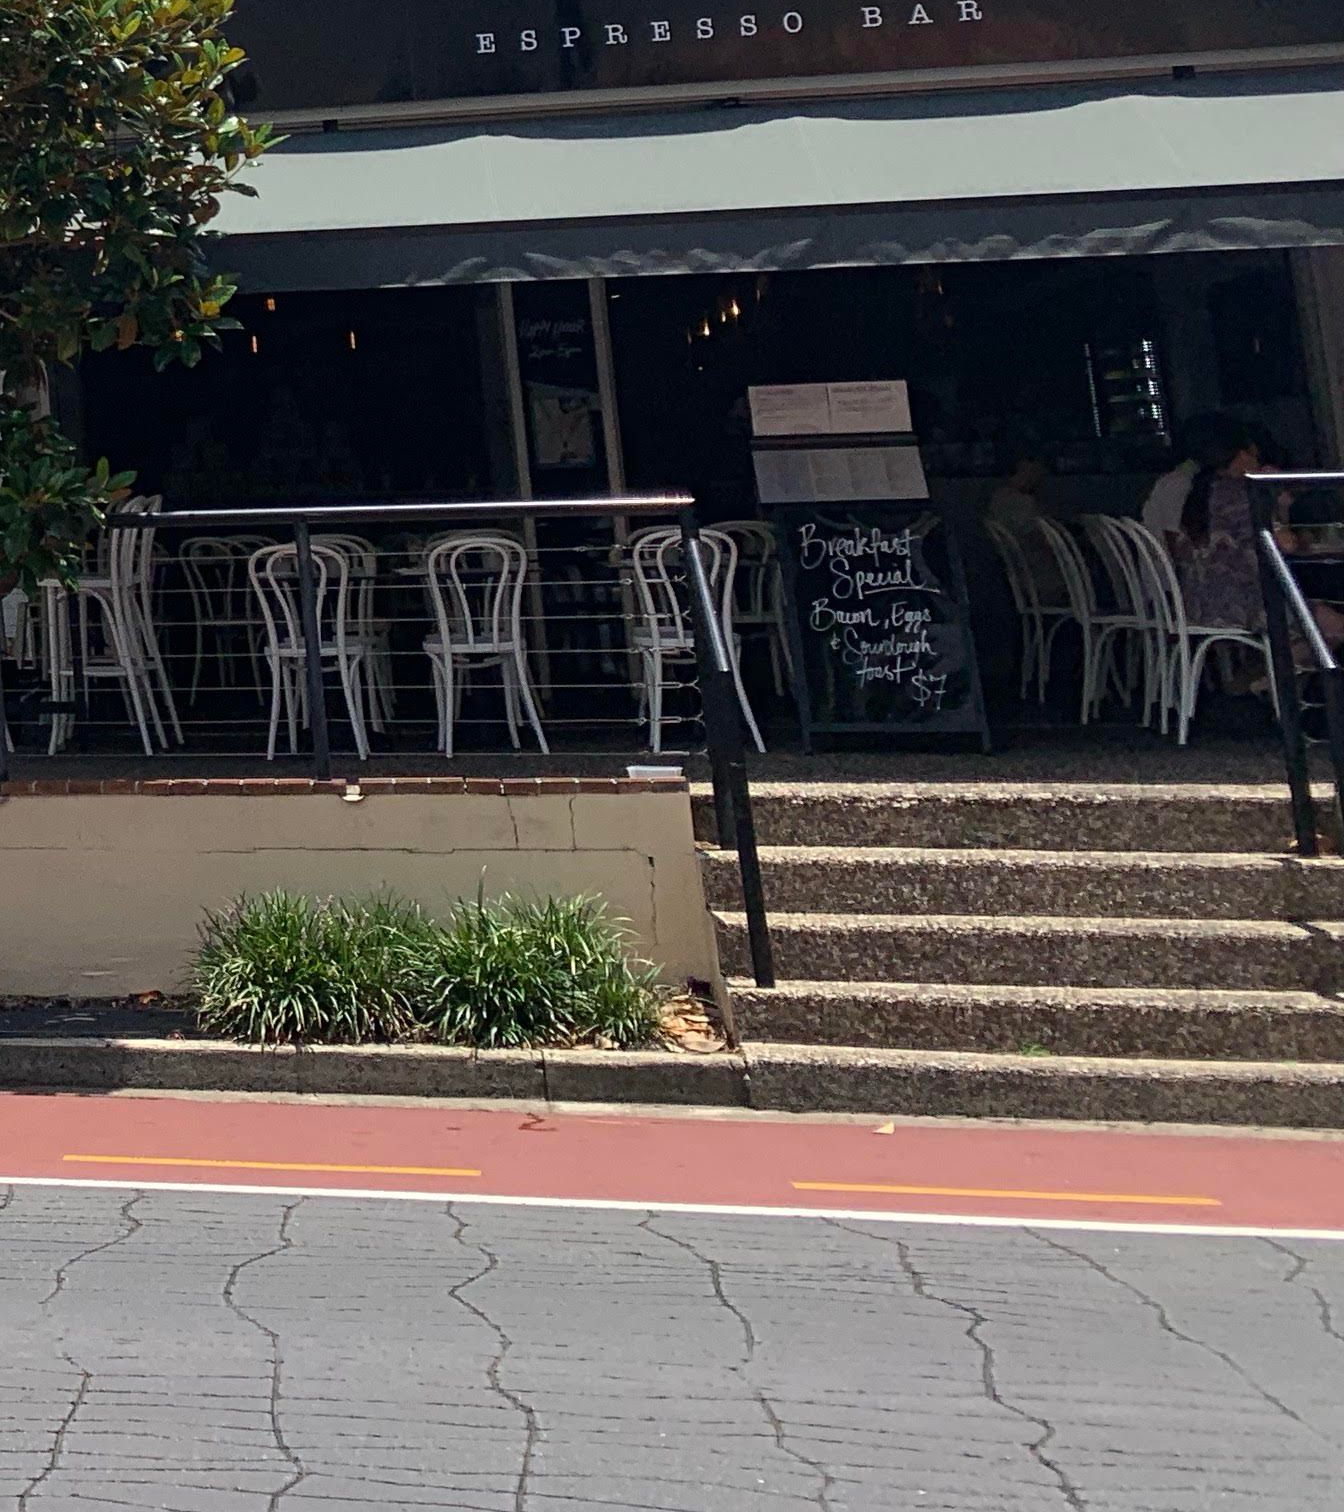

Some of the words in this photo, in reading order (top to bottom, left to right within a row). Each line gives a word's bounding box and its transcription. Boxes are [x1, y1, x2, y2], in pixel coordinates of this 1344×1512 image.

[475, 11, 804, 56] ESPRESSO
[861, 0, 984, 29] BAR
[799, 523, 921, 570] Breakfast
[829, 557, 928, 600] Special
[891, 601, 932, 633] Eggs
[842, 627, 938, 666] Sourdough
[911, 669, 948, 710] $7
